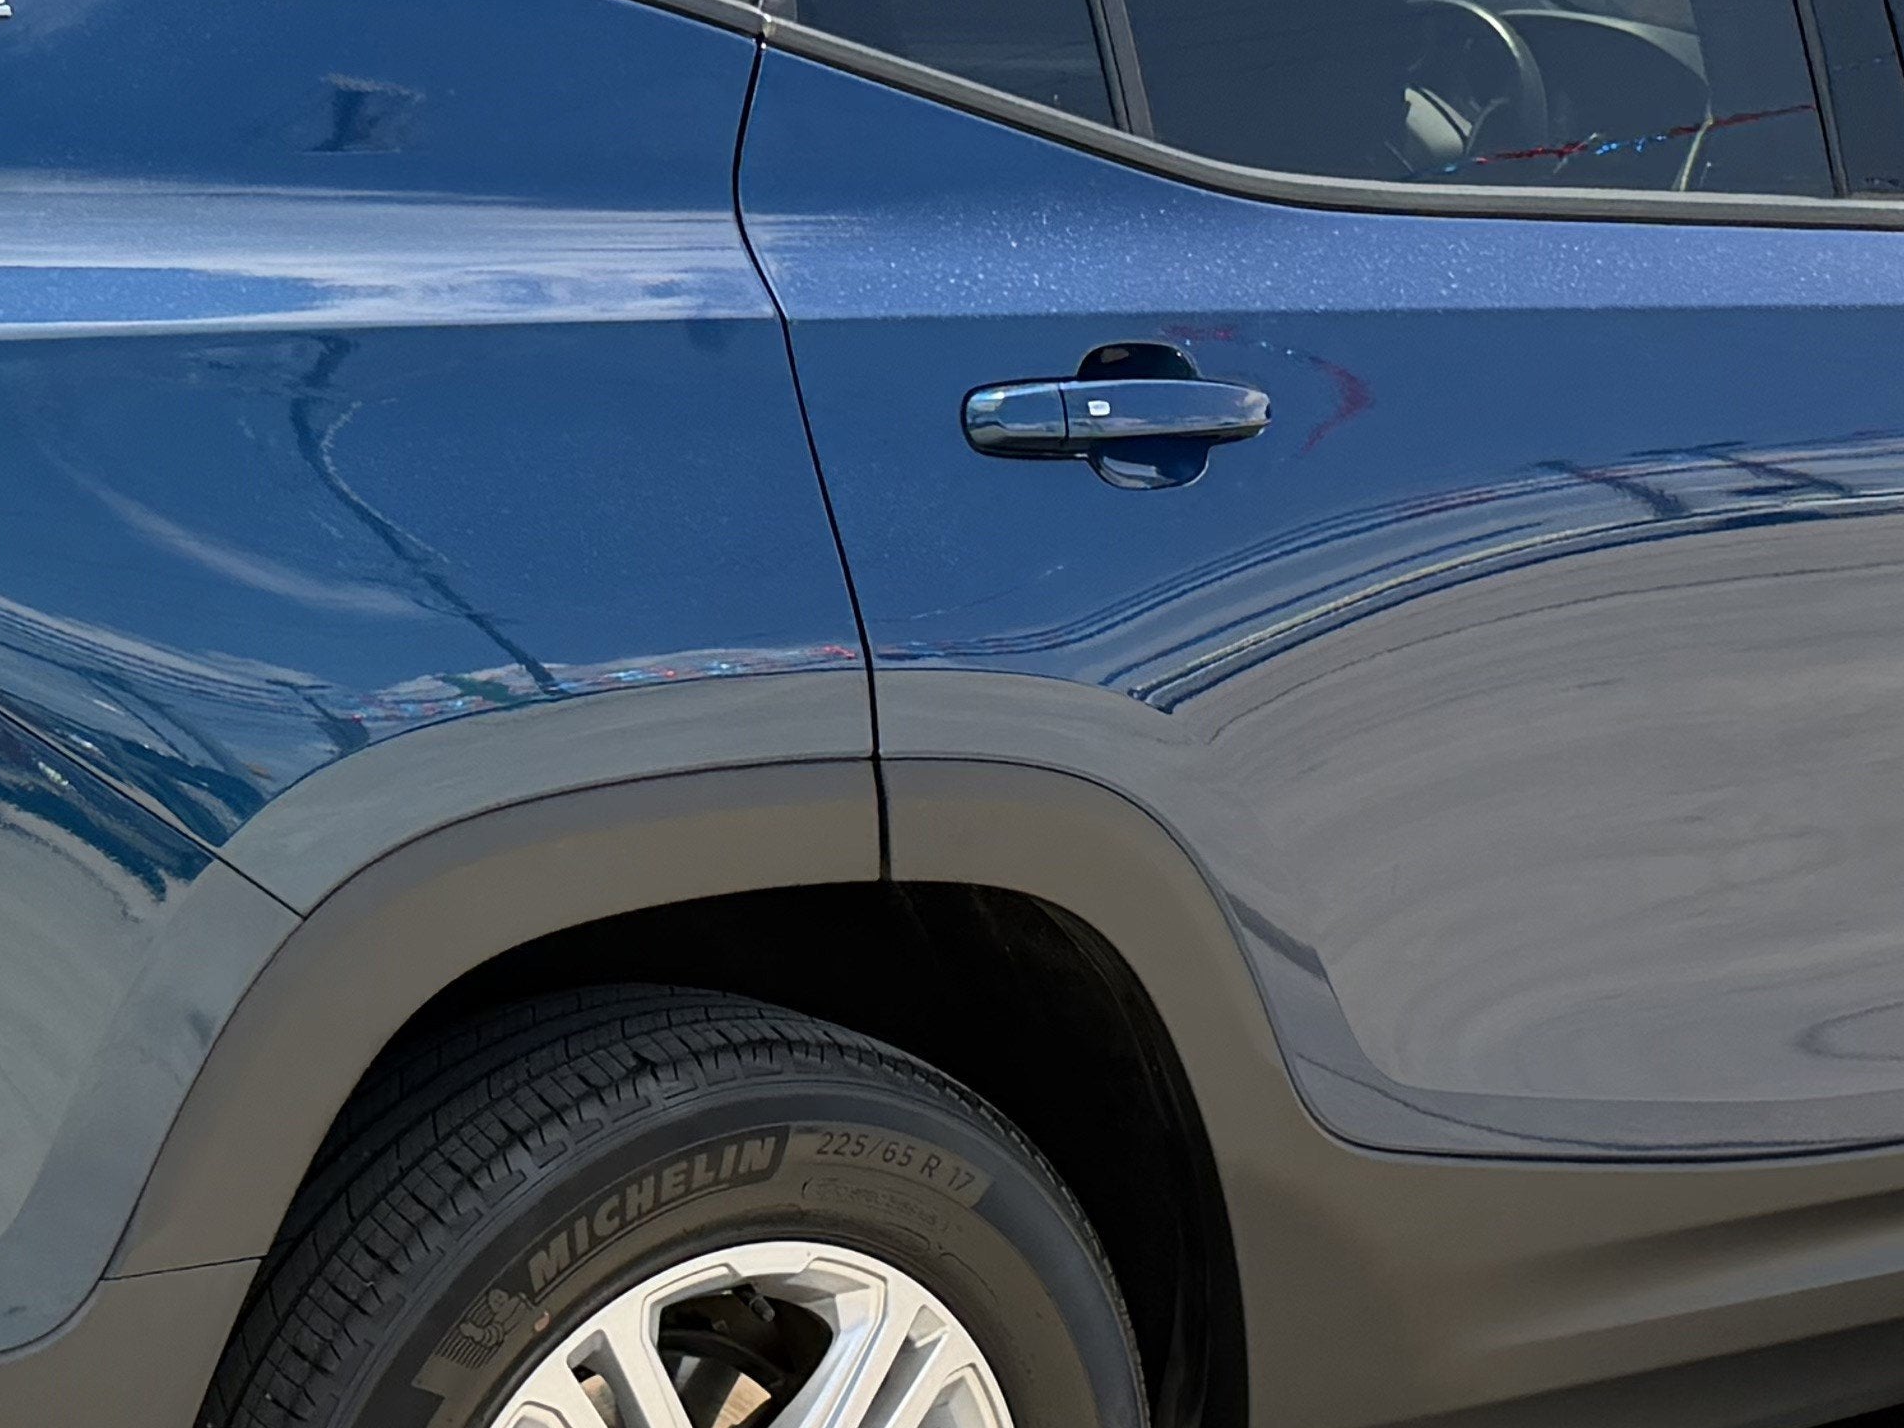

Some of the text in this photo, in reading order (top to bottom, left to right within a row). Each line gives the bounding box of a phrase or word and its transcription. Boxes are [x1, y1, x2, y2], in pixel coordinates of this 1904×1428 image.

[528, 1135, 777, 1293] MICHELIN
[815, 1130, 916, 1168] 225/65
[919, 1153, 942, 1179] R
[947, 1165, 976, 1193] 17
